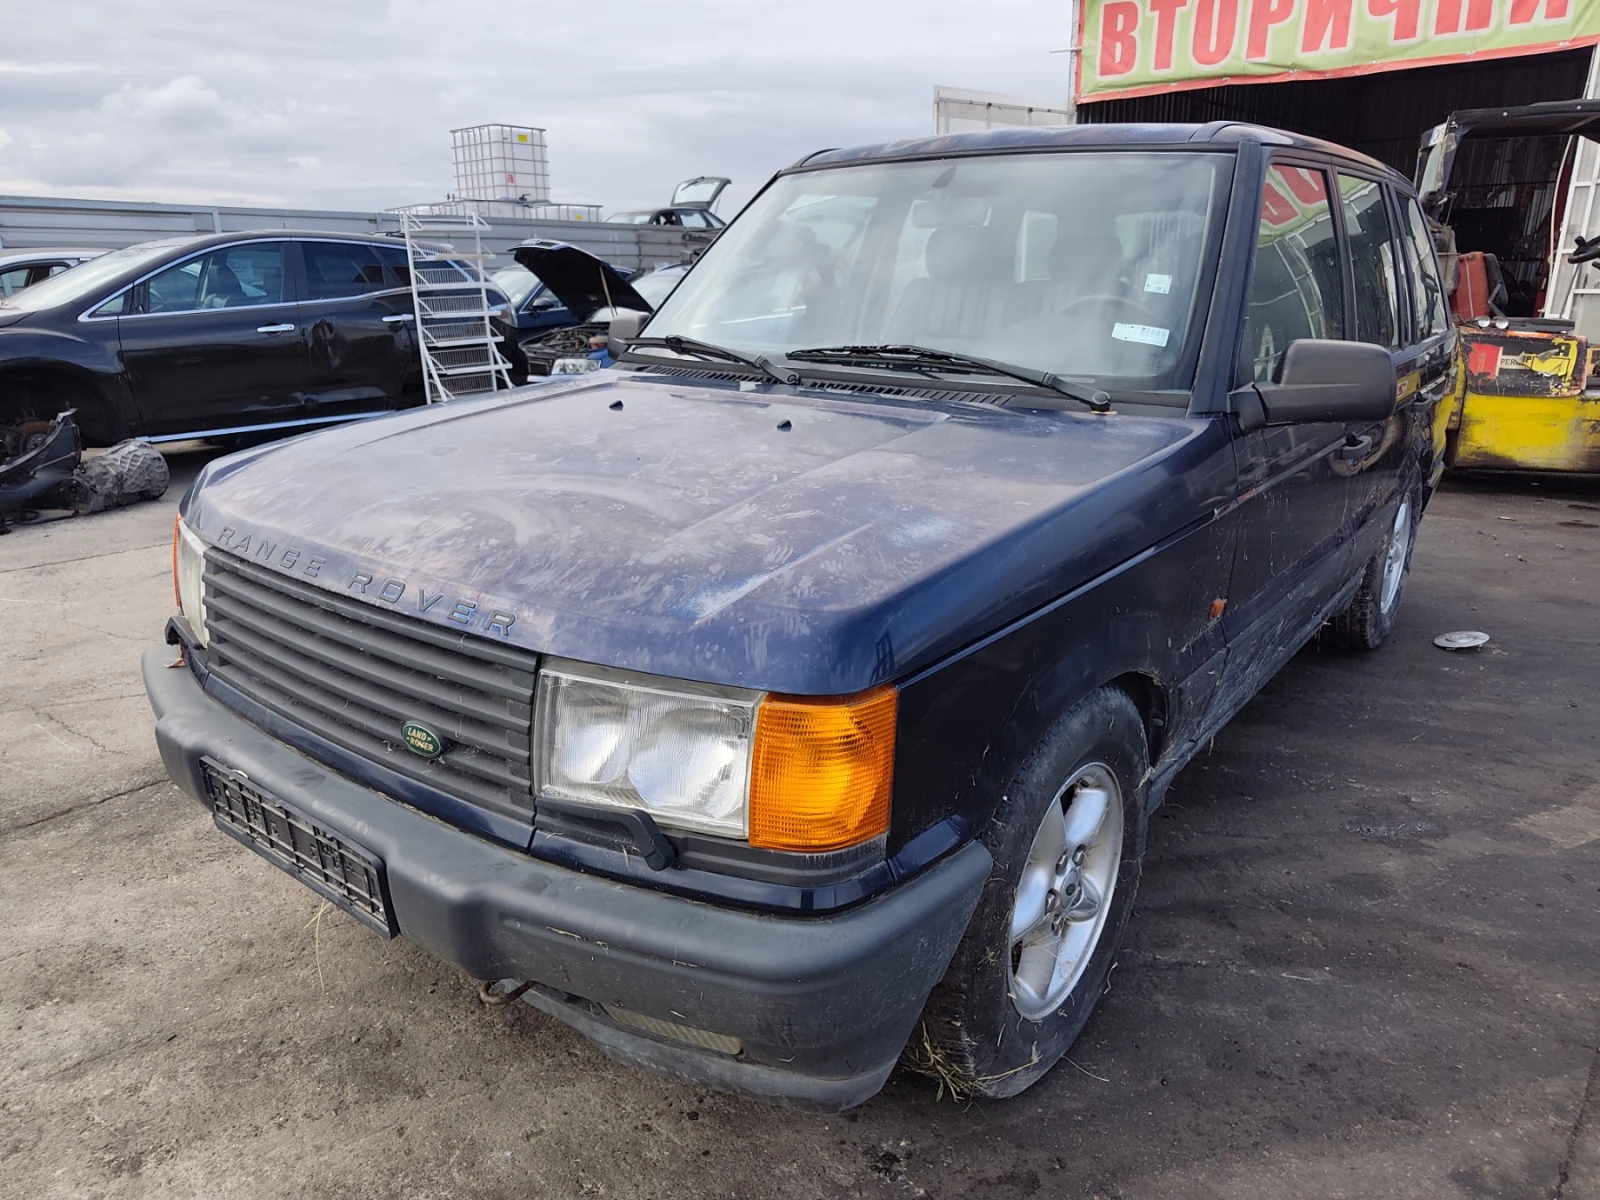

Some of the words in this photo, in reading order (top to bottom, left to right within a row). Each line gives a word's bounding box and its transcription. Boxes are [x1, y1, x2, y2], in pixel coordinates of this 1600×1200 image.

[216, 526, 327, 578] RANGE
[346, 571, 517, 637] ROVER
[407, 727, 428, 741] LAND
[409, 736, 434, 753] ROVER
